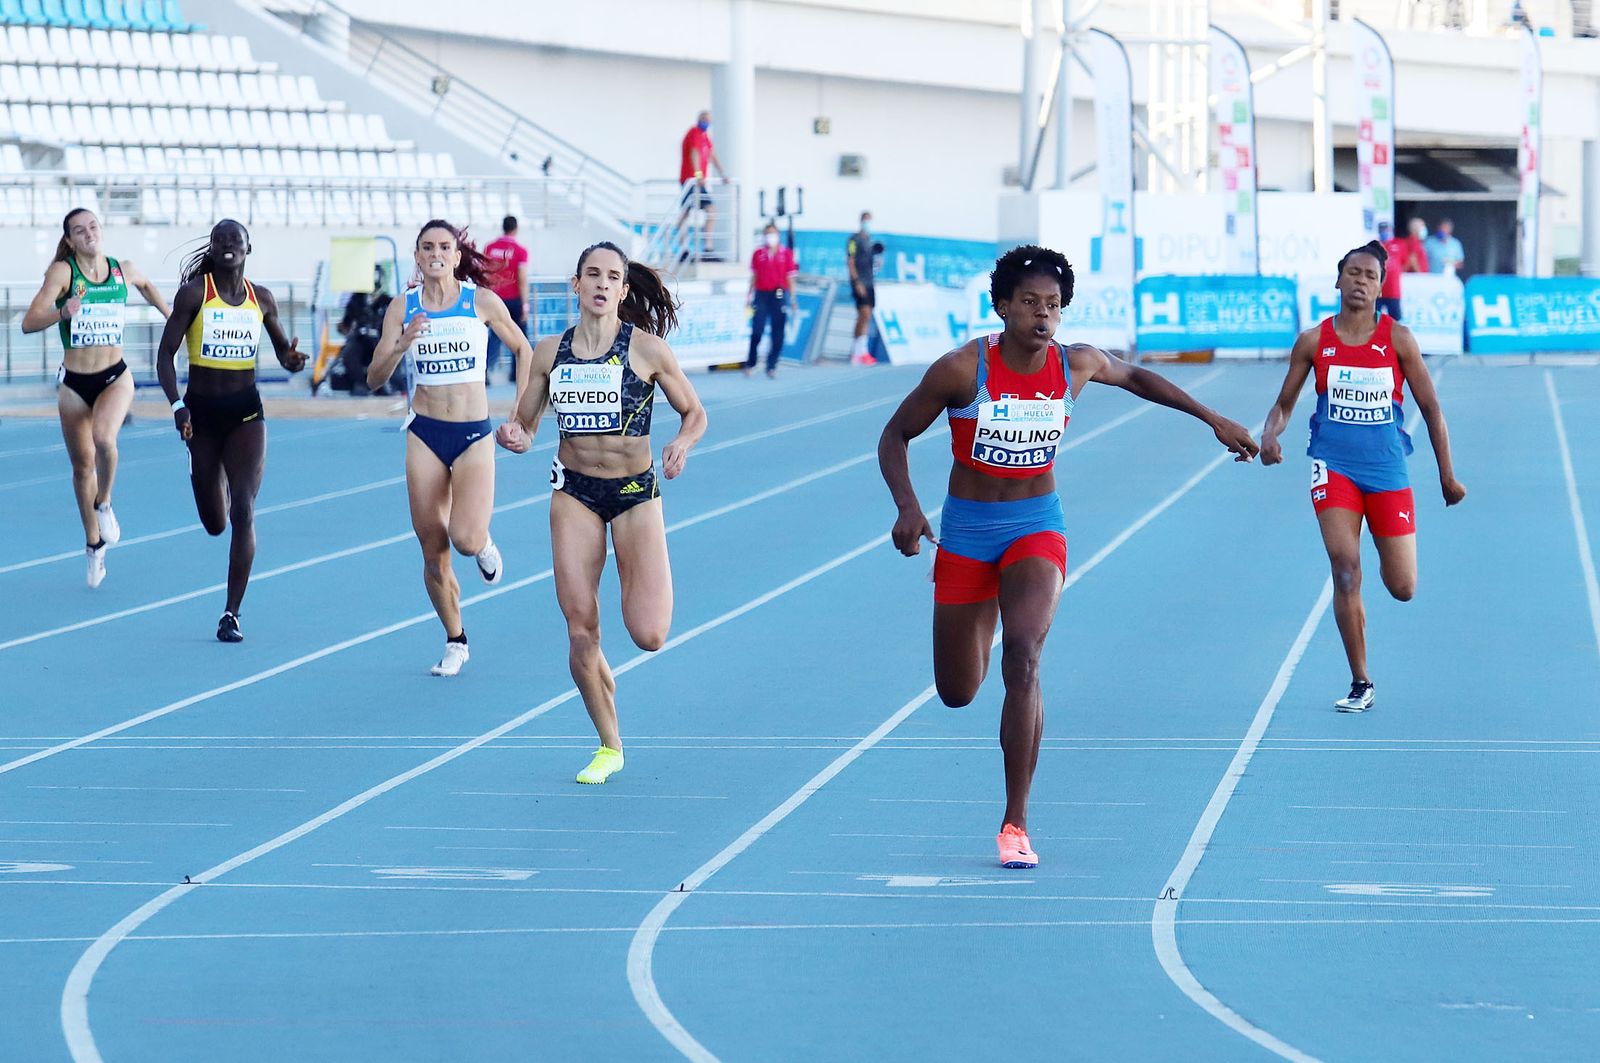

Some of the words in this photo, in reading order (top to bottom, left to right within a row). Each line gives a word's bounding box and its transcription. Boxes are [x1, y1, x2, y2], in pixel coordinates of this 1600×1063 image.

[1140, 292, 1180, 325] H
[1218, 303, 1292, 322] HUELVA
[1472, 293, 1512, 328] H
[213, 328, 253, 340] SHIDA
[418, 341, 470, 355] BUENO
[552, 391, 619, 404] AZEVEDO
[1332, 388, 1388, 402] MEDINA
[993, 404, 1008, 417] H
[979, 428, 1061, 443] PAULINO
[1313, 462, 1321, 483] 3
